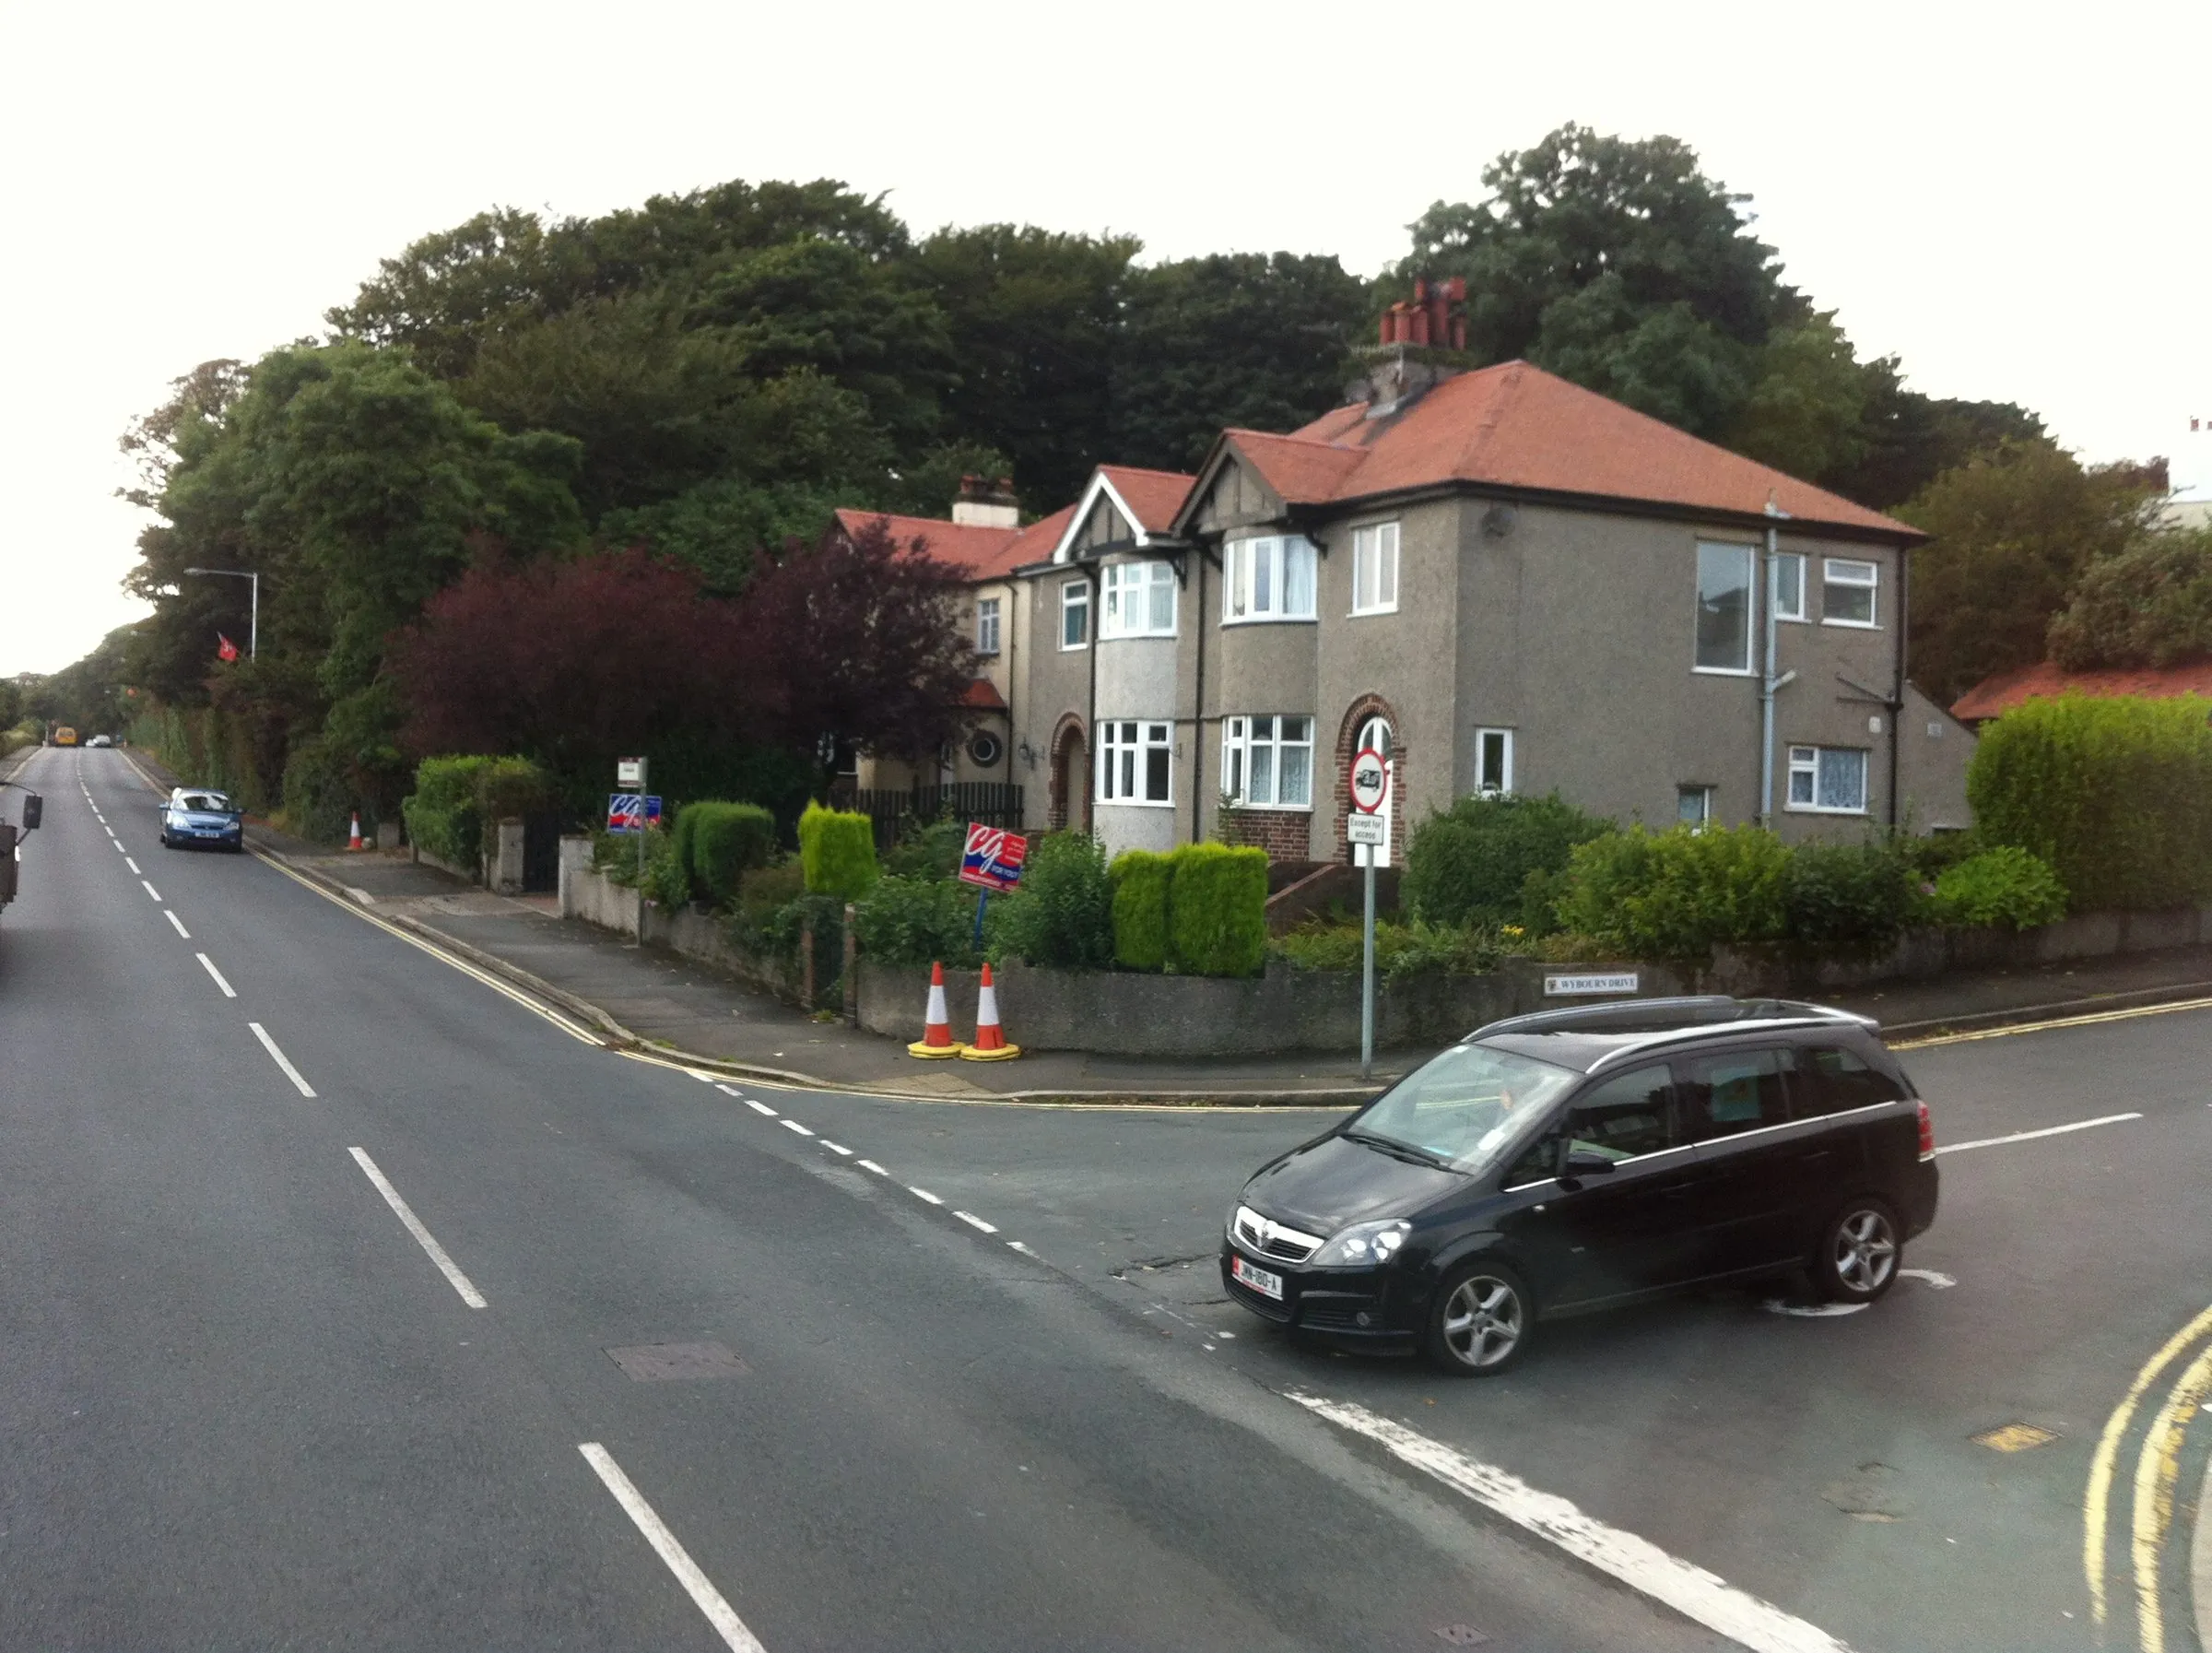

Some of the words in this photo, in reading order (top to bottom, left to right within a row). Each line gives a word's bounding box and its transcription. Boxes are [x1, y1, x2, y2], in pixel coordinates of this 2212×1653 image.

[1349, 817, 1371, 828] Except
[1372, 819, 1382, 828] for
[1355, 831, 1376, 840] access
[1561, 978, 1606, 989] WYBOURN
[1608, 977, 1634, 988] DRIVE
